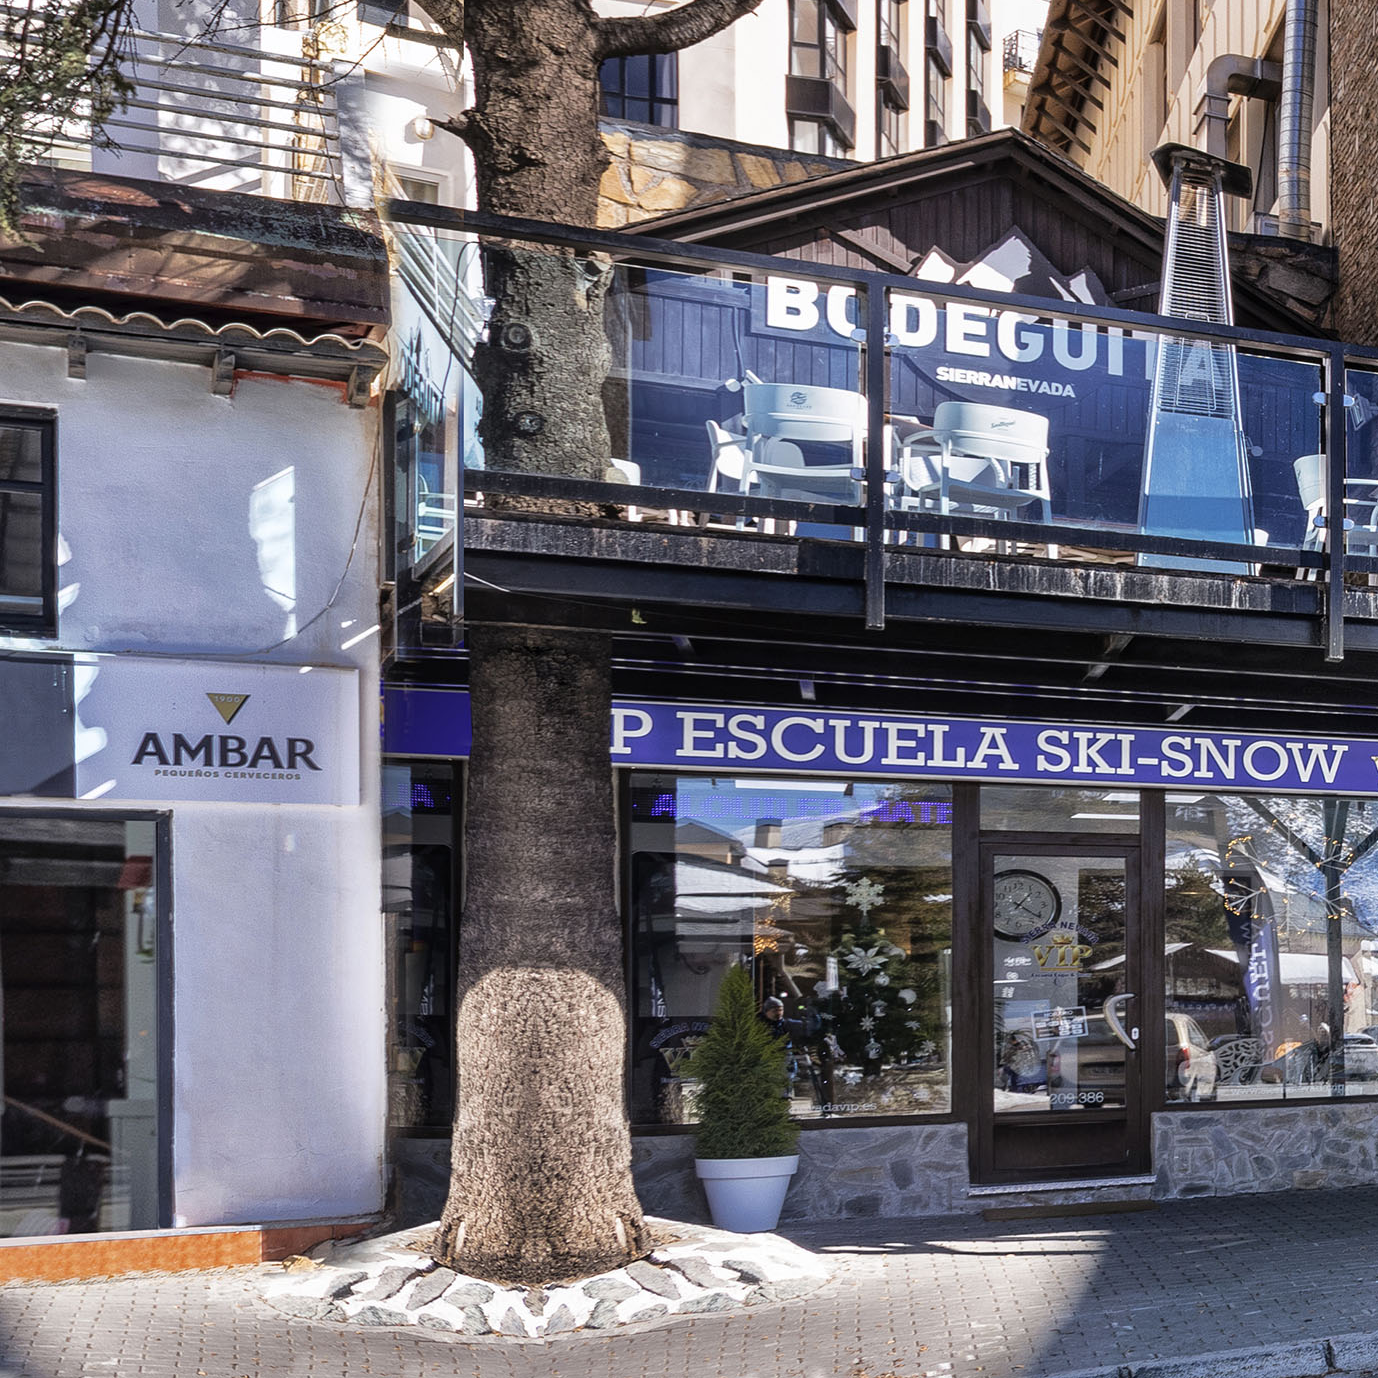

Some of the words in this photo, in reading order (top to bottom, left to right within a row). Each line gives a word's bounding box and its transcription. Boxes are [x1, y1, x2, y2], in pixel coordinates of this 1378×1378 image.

[214, 695, 241, 703] 1900
[130, 732, 323, 771] AMBAR
[675, 711, 1020, 771] ESCUELA
[1035, 729, 1348, 785] SKI-SNOW
[154, 769, 220, 778] PEQUEÑOS
[224, 771, 301, 781] CERVECEROS
[1032, 944, 1093, 967] VIP
[1050, 1093, 1075, 1105] 209
[1078, 1091, 1104, 1103] 386
